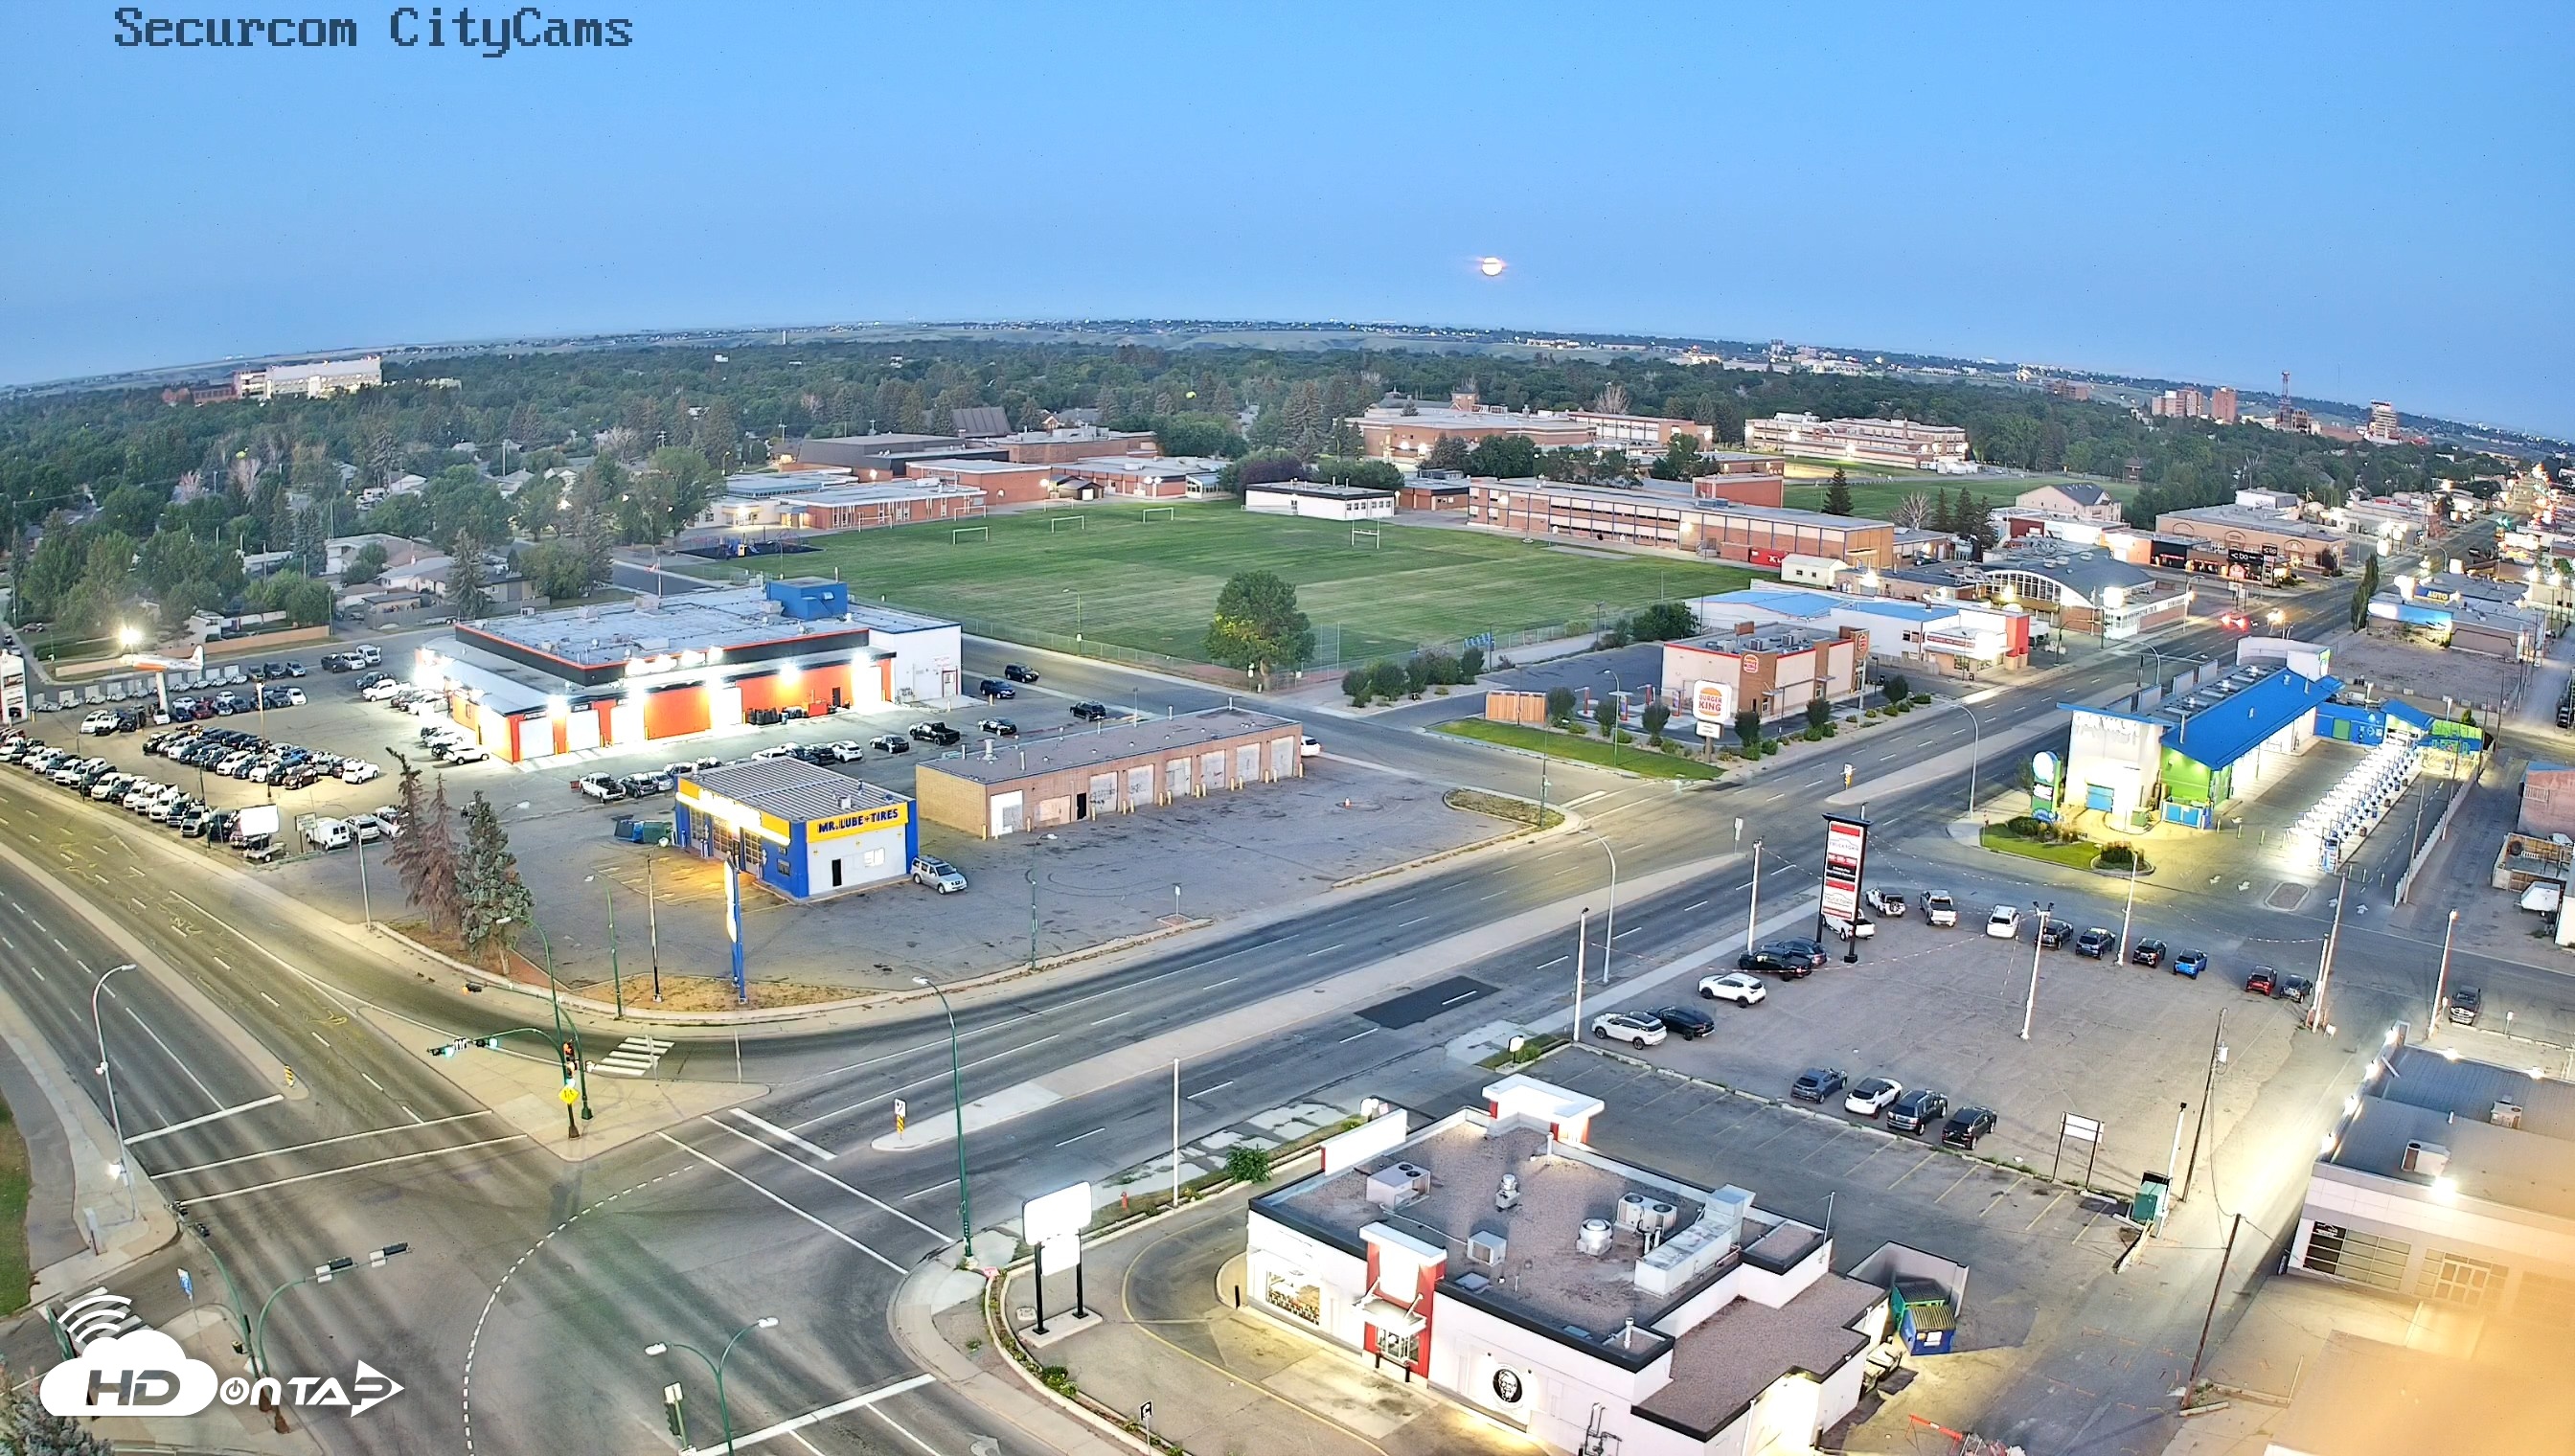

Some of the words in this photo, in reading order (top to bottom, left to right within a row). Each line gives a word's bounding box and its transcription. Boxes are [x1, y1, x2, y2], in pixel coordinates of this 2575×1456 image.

[1698, 694, 1722, 704] BURGER
[1698, 700, 1721, 712] KING
[839, 815, 864, 829] LUBE
[869, 808, 899, 822] TIRES
